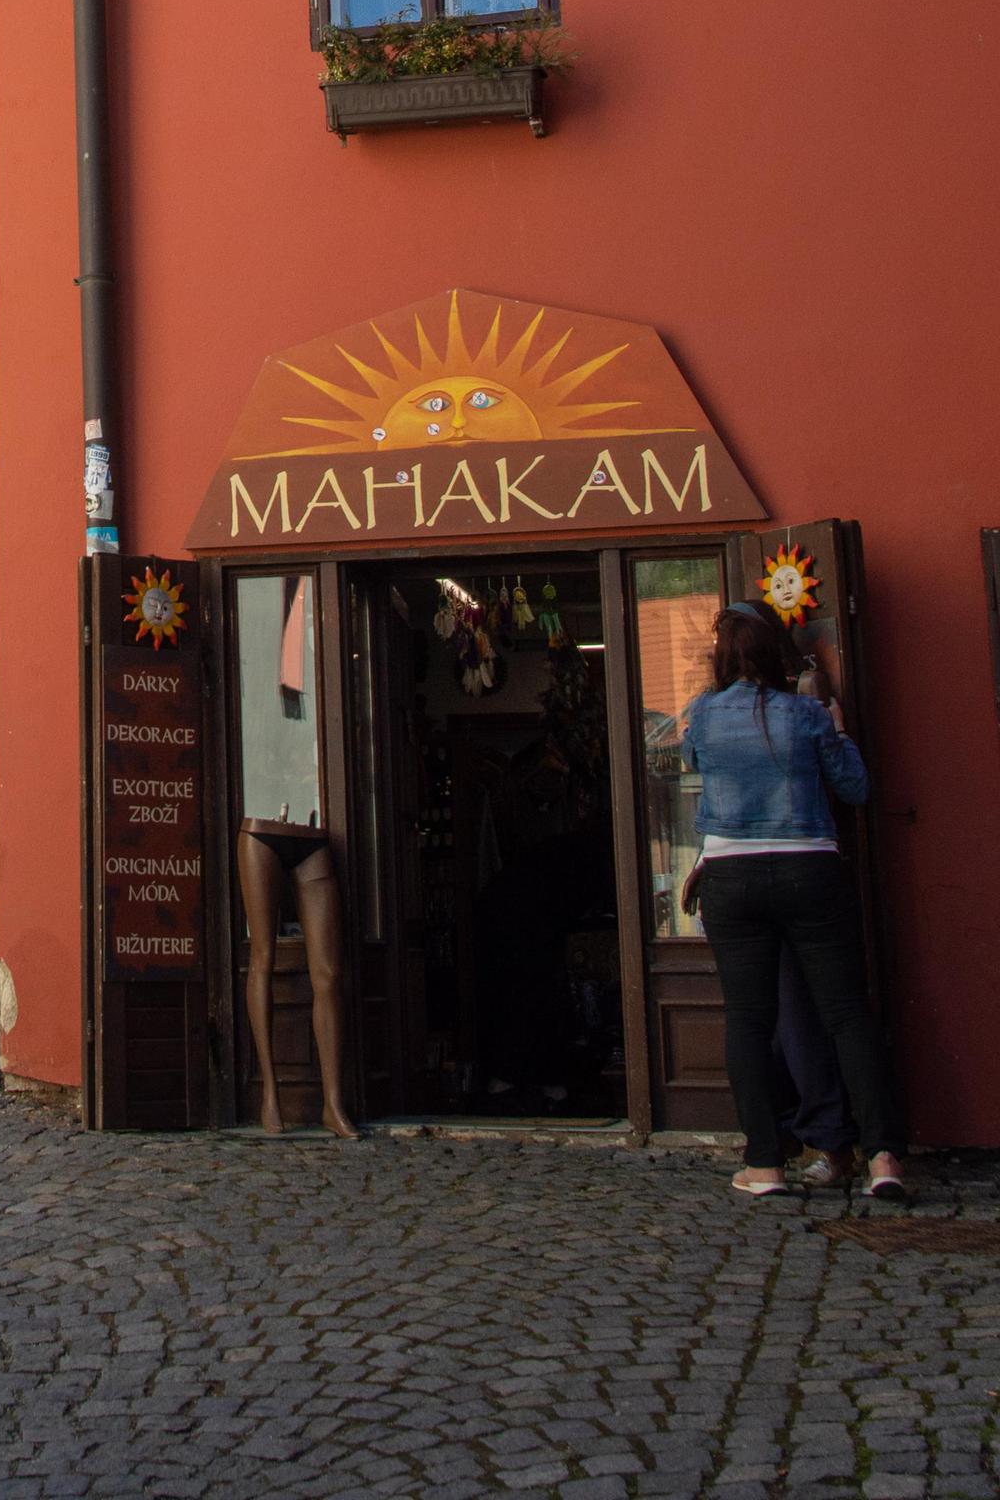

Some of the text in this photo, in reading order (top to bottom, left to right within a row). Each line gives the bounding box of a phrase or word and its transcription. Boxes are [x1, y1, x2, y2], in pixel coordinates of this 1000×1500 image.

[230, 444, 713, 537] MAHAKAM
[123, 671, 180, 693] DÁRKY
[107, 723, 196, 745] DEKORACE
[112, 777, 194, 799] EXOTICKÉ
[128, 802, 181, 824] ZBOŽÍ
[106, 854, 201, 877] ORIGINÁLNÍ
[128, 880, 181, 902] MÓDA
[116, 933, 195, 955] BIŽUTERIE
